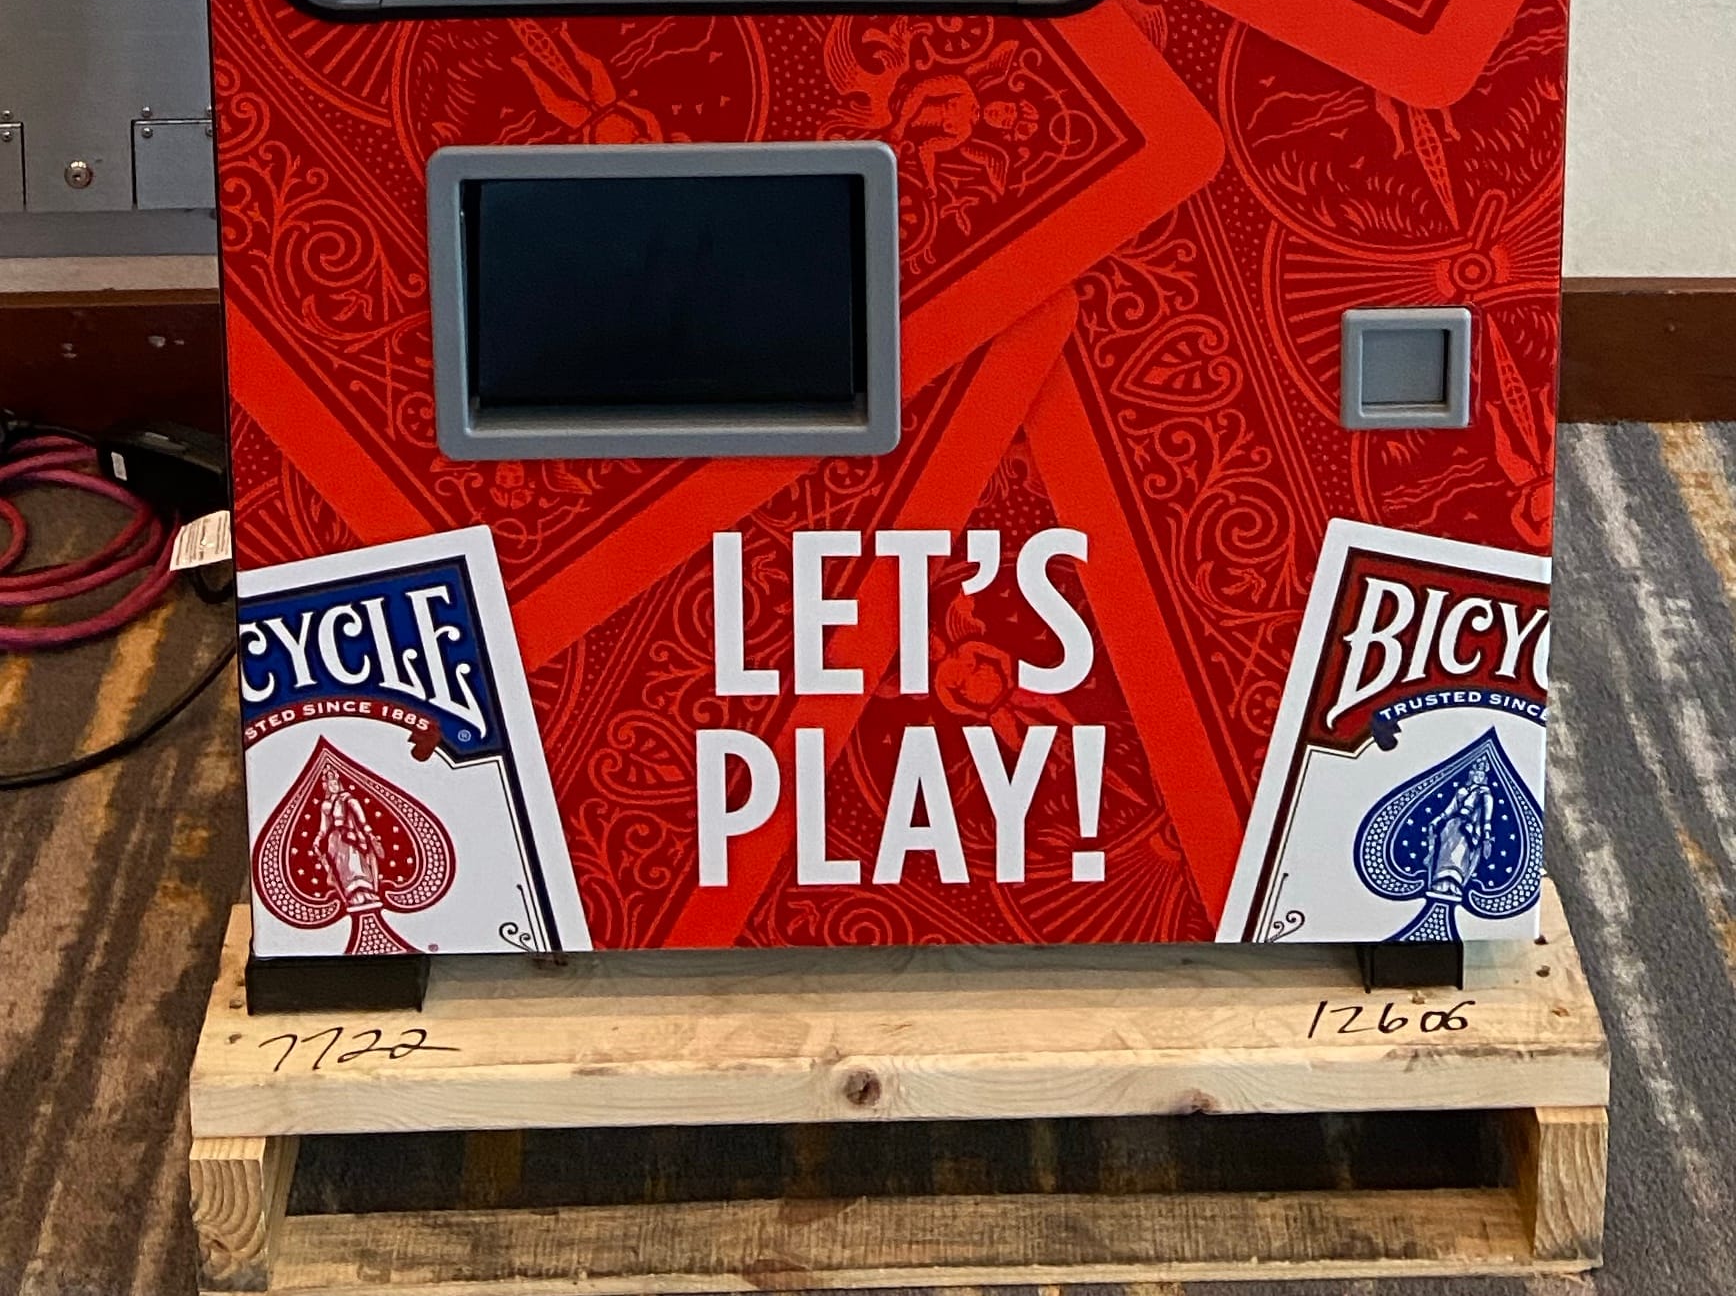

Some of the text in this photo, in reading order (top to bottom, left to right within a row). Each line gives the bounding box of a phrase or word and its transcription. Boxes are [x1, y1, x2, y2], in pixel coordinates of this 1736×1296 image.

[239, 585, 486, 745] CYCLE
[712, 528, 1095, 697] LET'S
[244, 701, 430, 739] STED SINCE 1885
[1380, 691, 1482, 721] TRUSTED
[697, 724, 1106, 888] PLAY!
